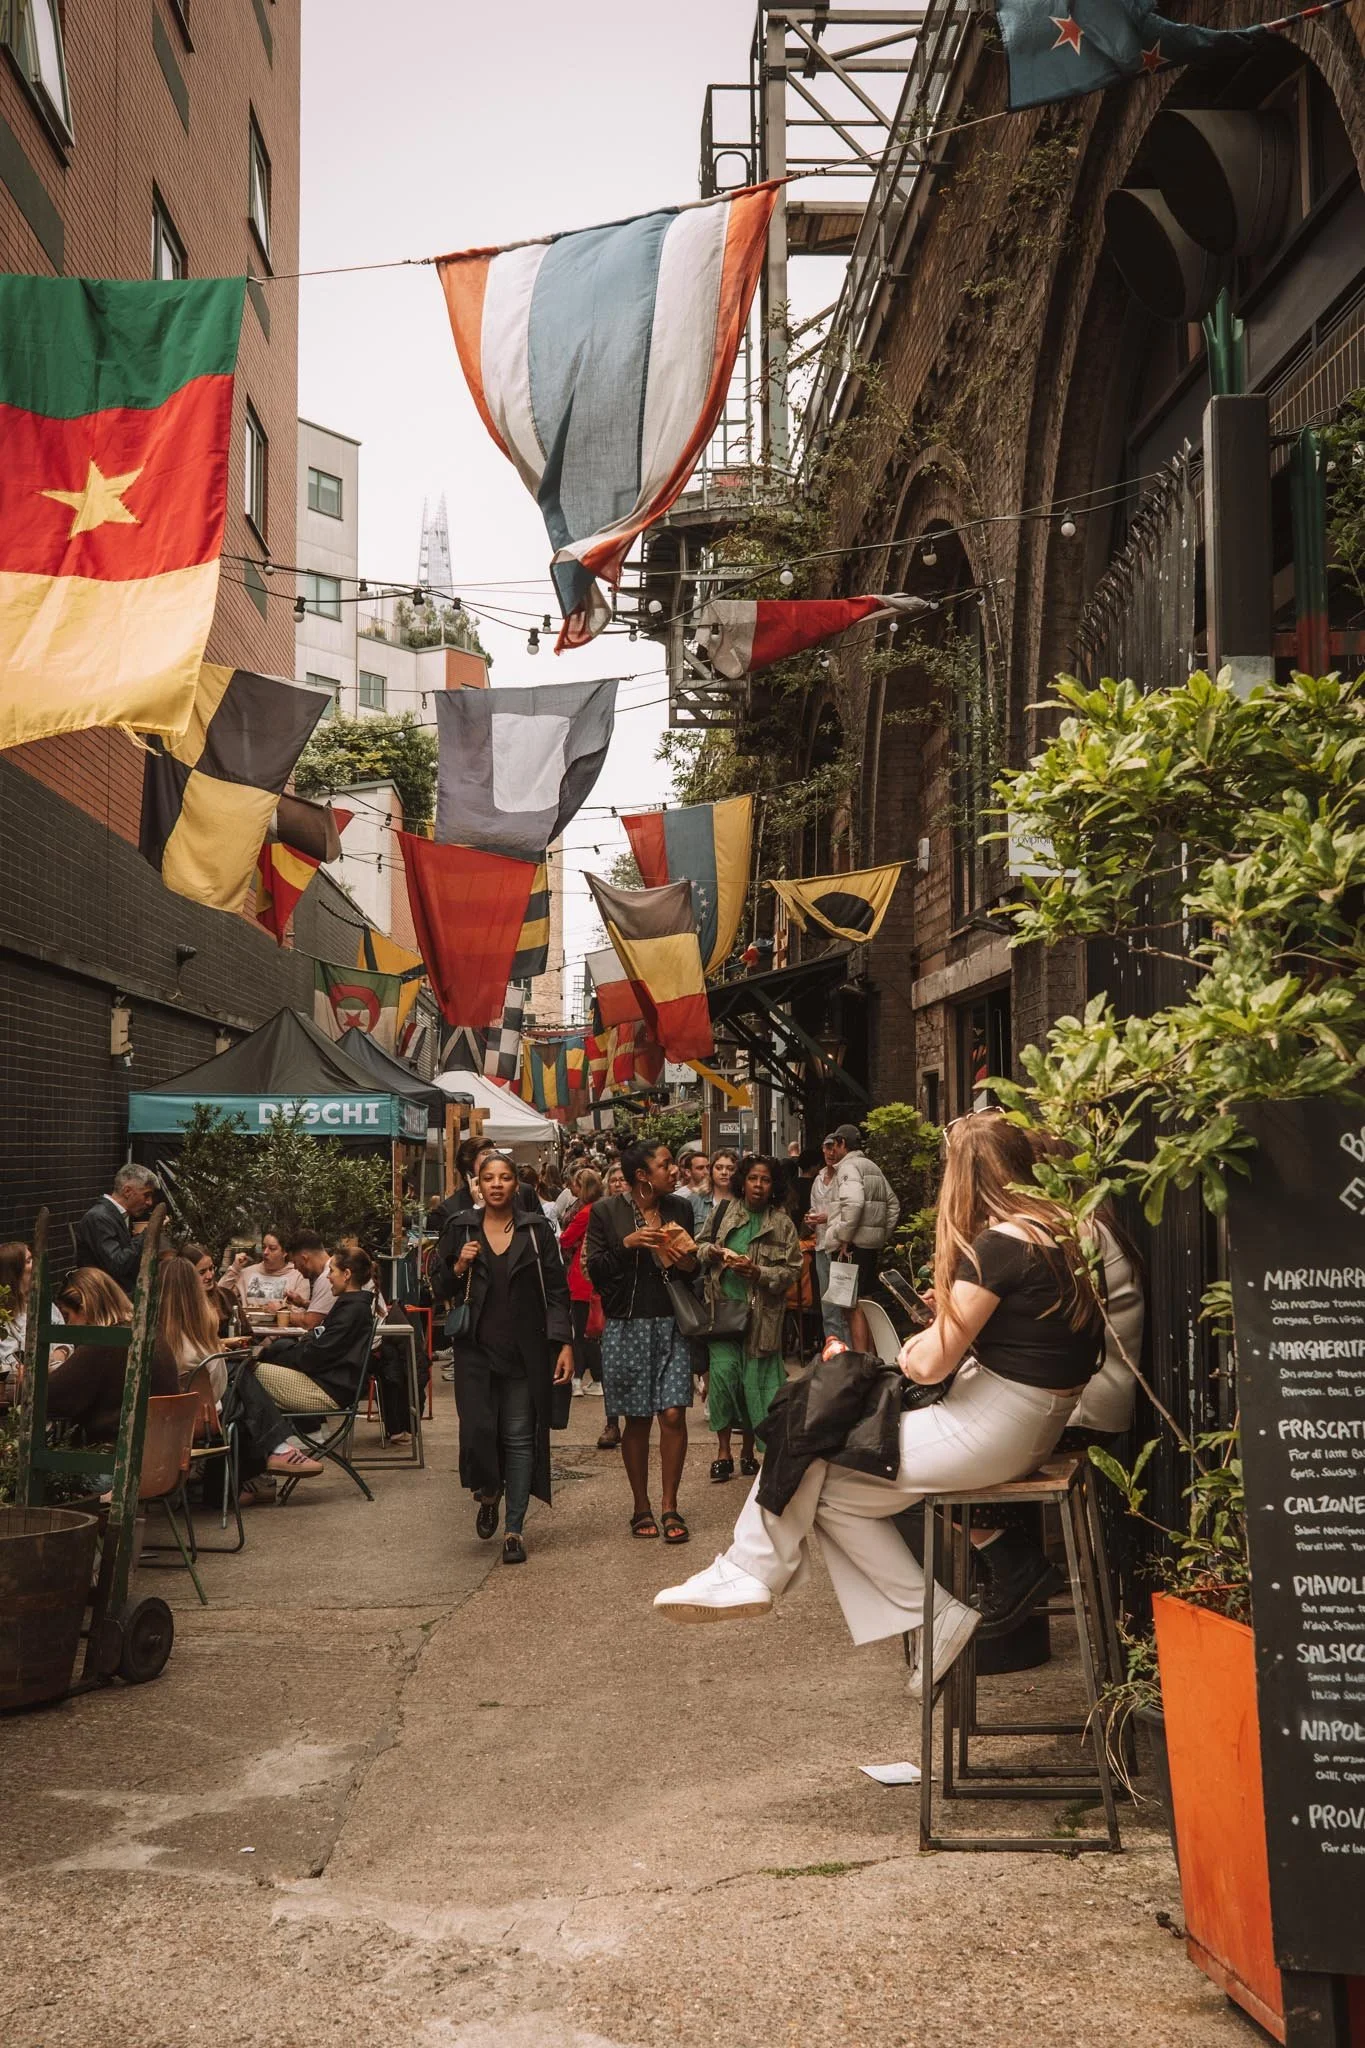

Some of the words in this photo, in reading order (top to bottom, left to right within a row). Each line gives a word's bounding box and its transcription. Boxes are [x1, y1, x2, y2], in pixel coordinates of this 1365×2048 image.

[258, 1102, 380, 1125] DEGCHI
[1263, 1266, 1365, 1291] MARINARA
[1270, 1298, 1289, 1311] San
[1283, 1495, 1365, 1515] CALZONE
[1308, 1804, 1365, 1830] PROV
